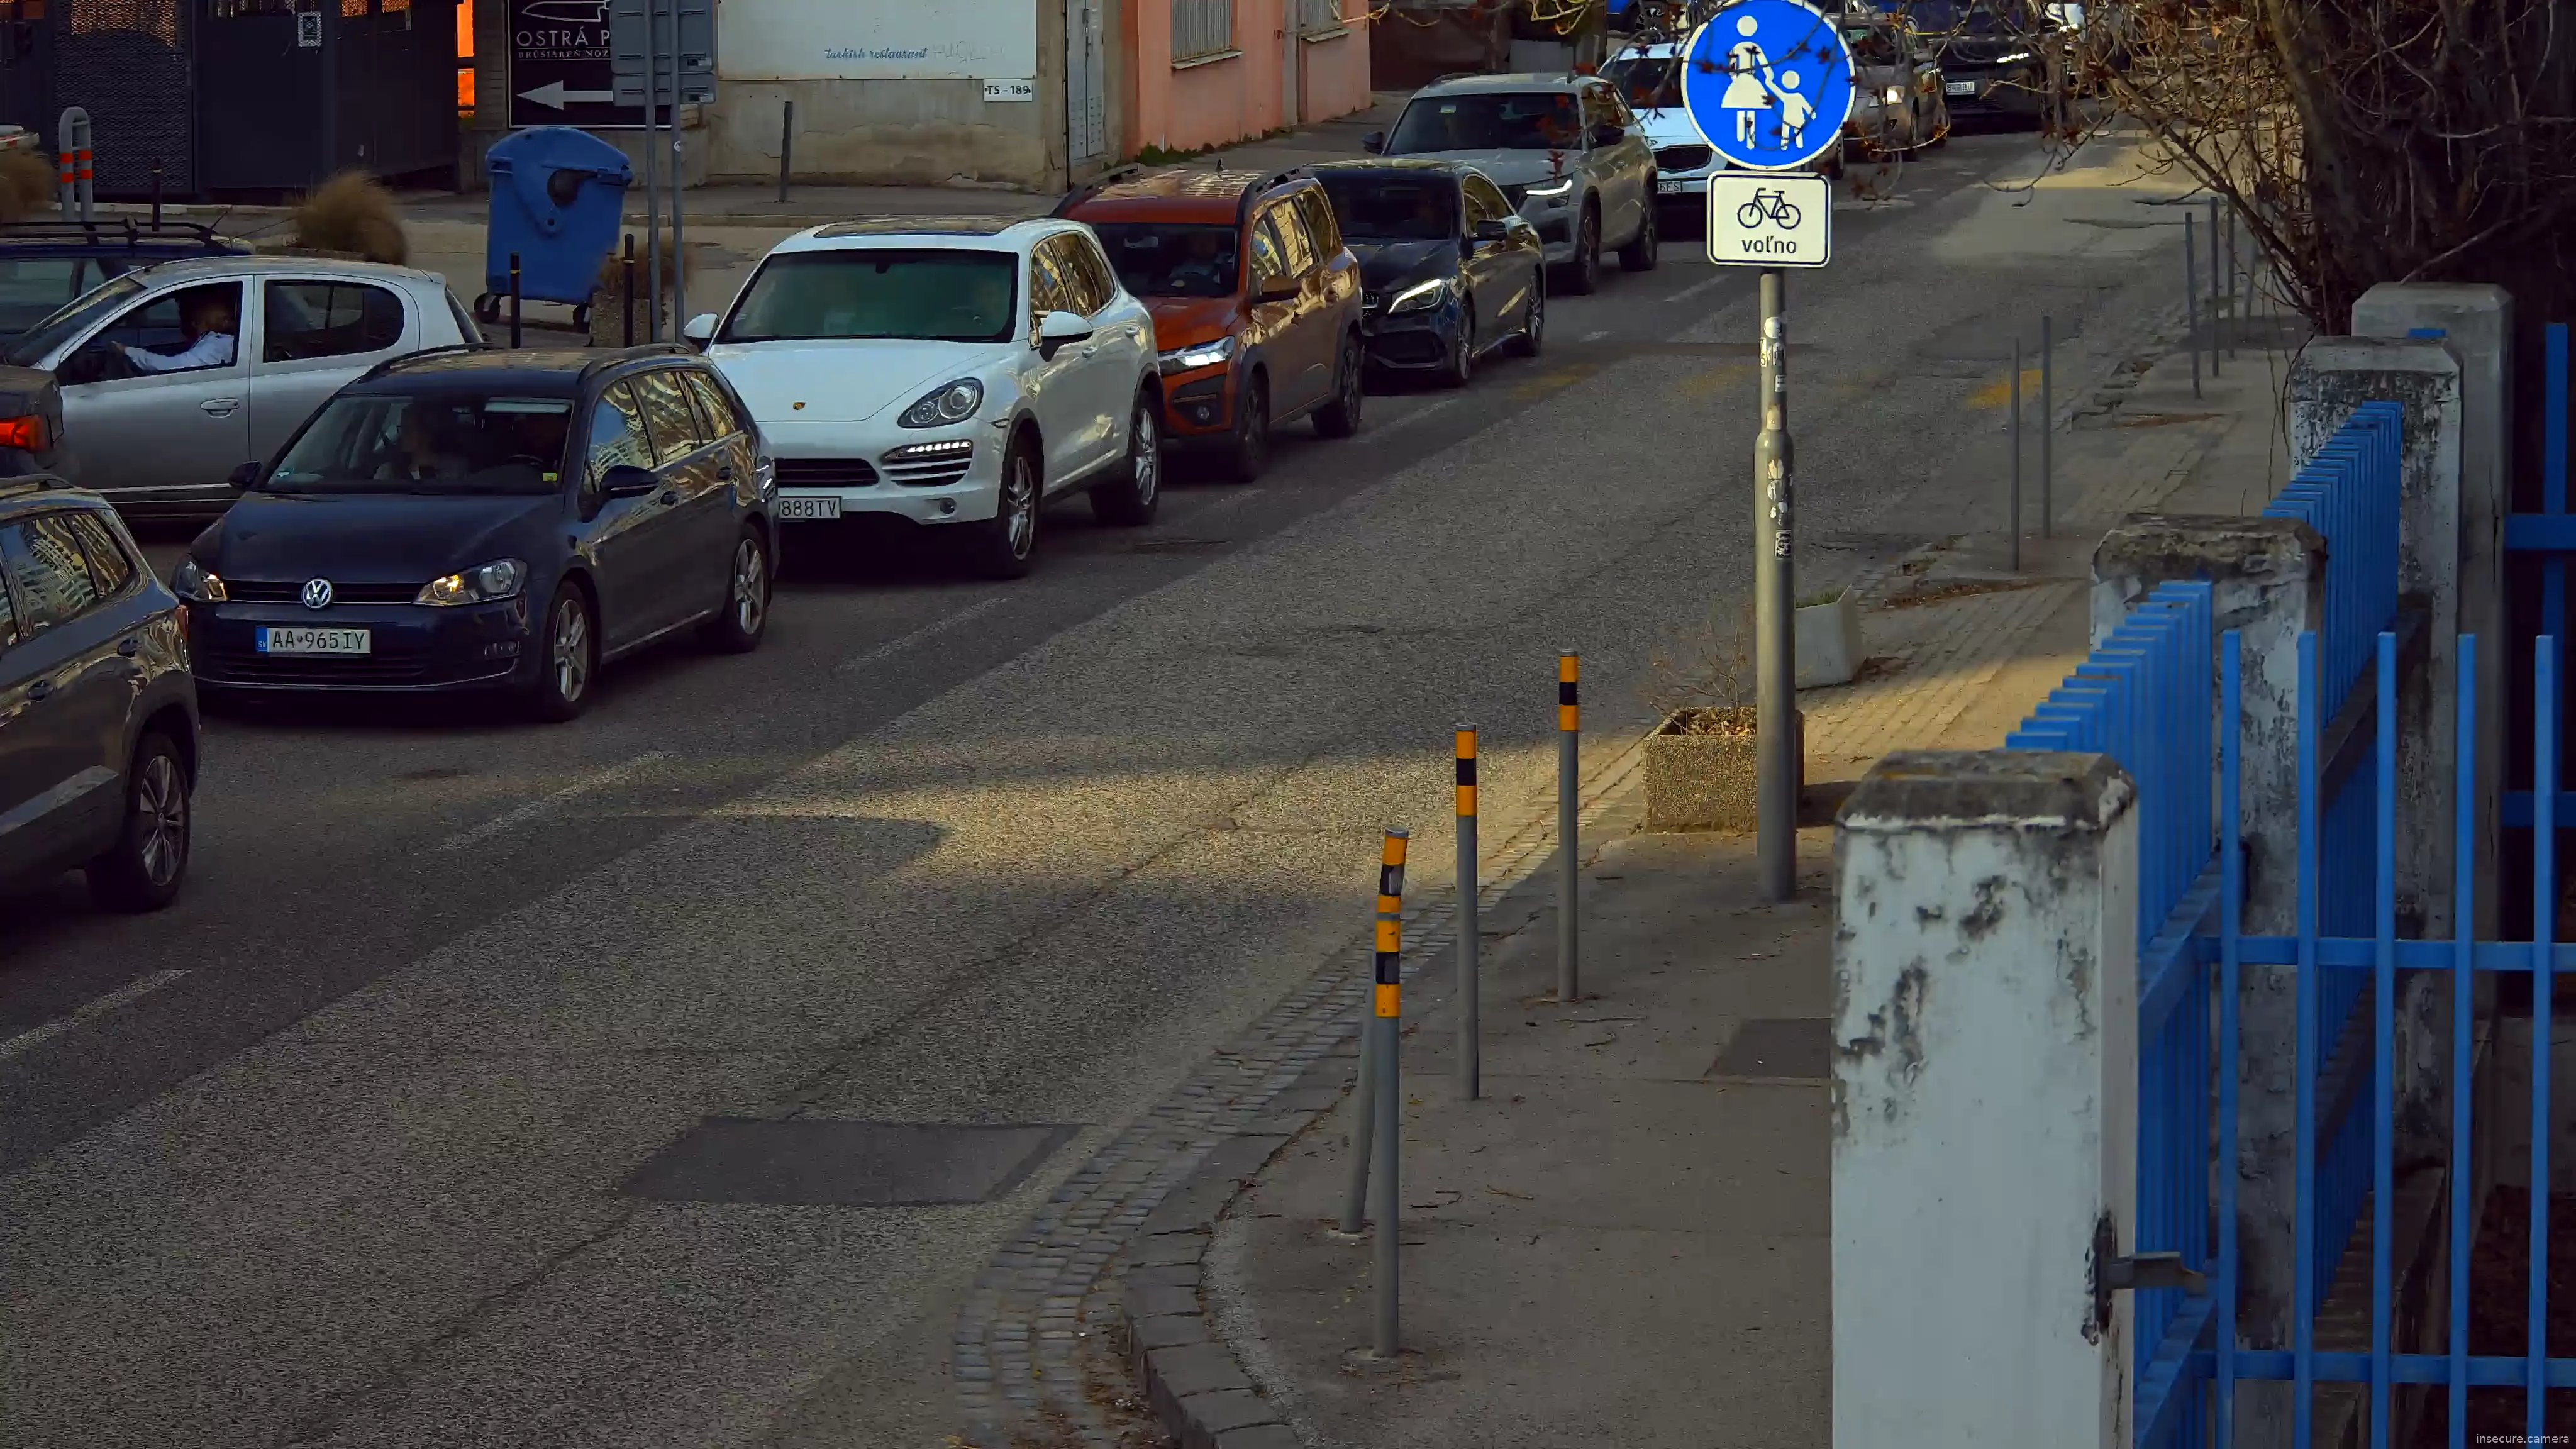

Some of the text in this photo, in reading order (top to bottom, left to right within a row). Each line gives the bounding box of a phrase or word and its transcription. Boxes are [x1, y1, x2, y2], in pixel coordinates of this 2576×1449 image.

[516, 26, 589, 47] OSTRÁ
[870, 48, 928, 59] restaurant
[987, 86, 1000, 94] TS
[1010, 85, 1028, 95] 189
[1741, 235, 1797, 253] voľno
